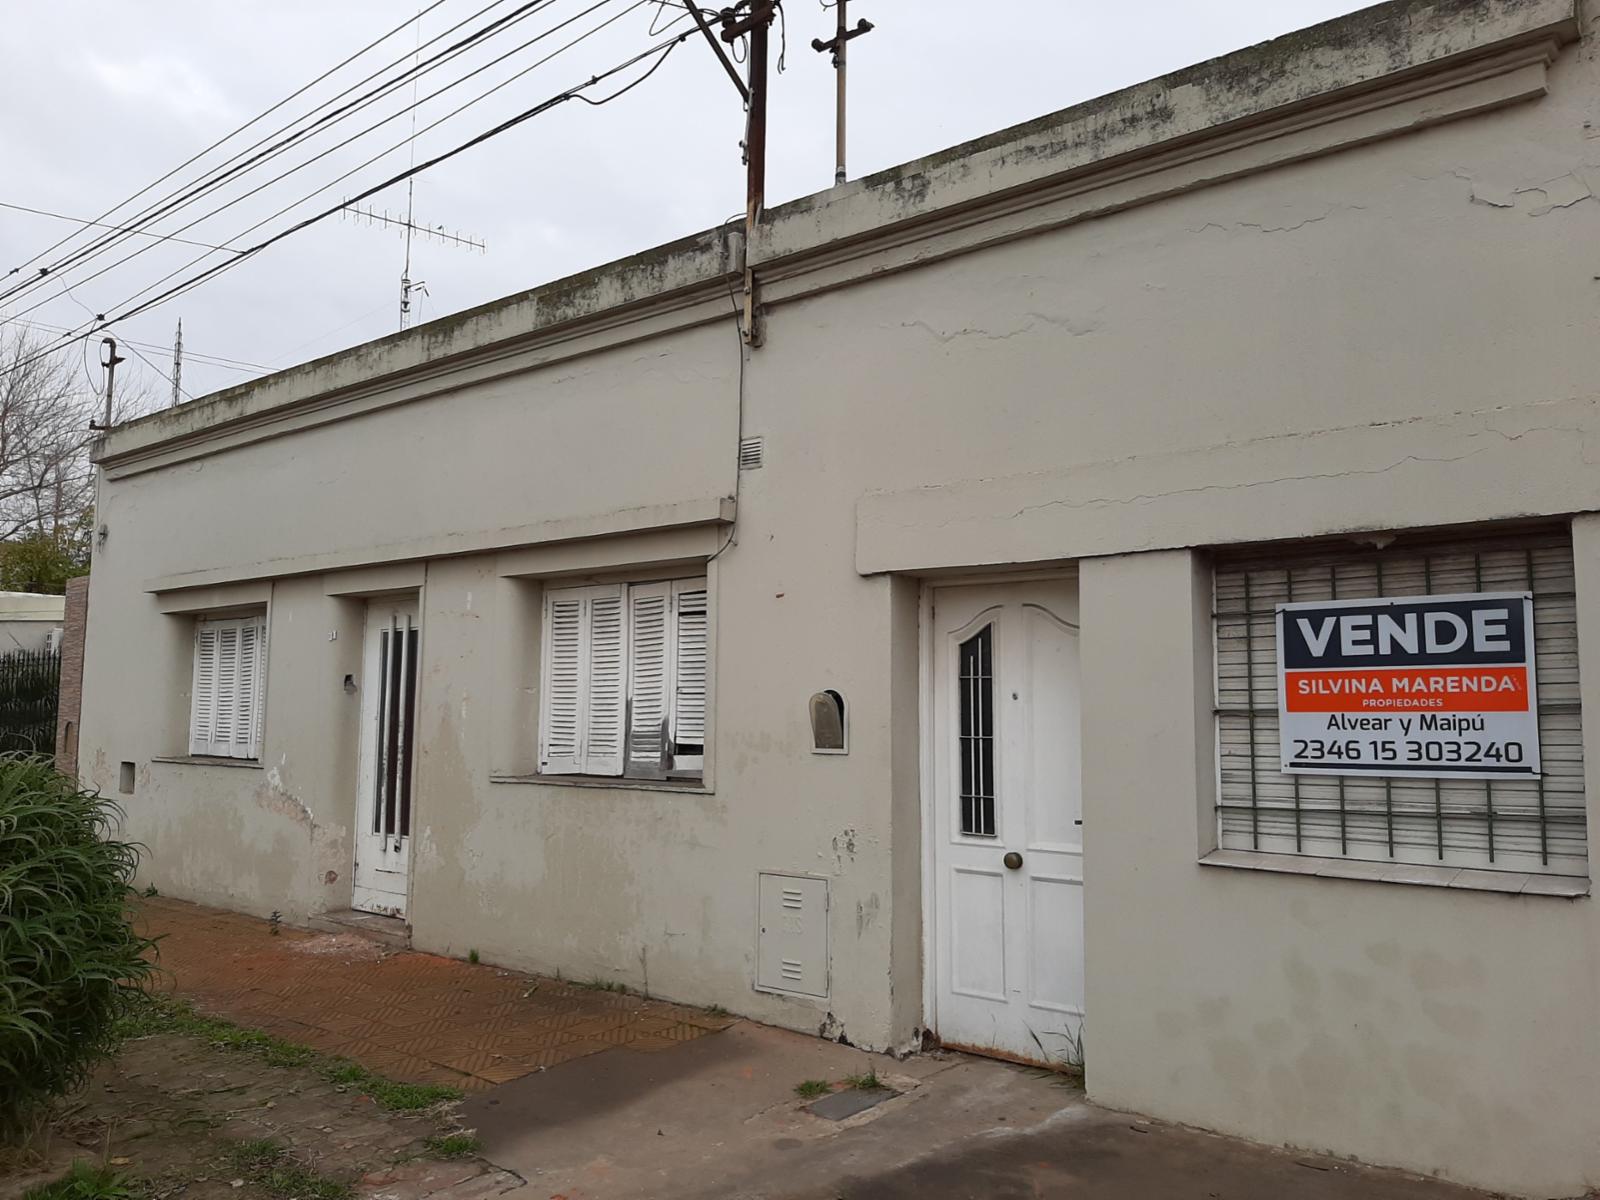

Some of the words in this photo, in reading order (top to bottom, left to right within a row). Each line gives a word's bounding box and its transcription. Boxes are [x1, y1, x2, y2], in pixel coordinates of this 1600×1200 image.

[1296, 608, 1511, 658] VENDE
[1298, 677, 1384, 695] SILVINA
[1391, 675, 1516, 693] MARENDA
[1362, 698, 1443, 708] PROPIEDADES
[1327, 713, 1392, 731] Alvear
[1399, 718, 1412, 736] y
[1419, 713, 1485, 737] Maipú
[1293, 739, 1361, 761] 2346
[1369, 740, 1397, 761] 15
[1406, 741, 1523, 763] 303240
